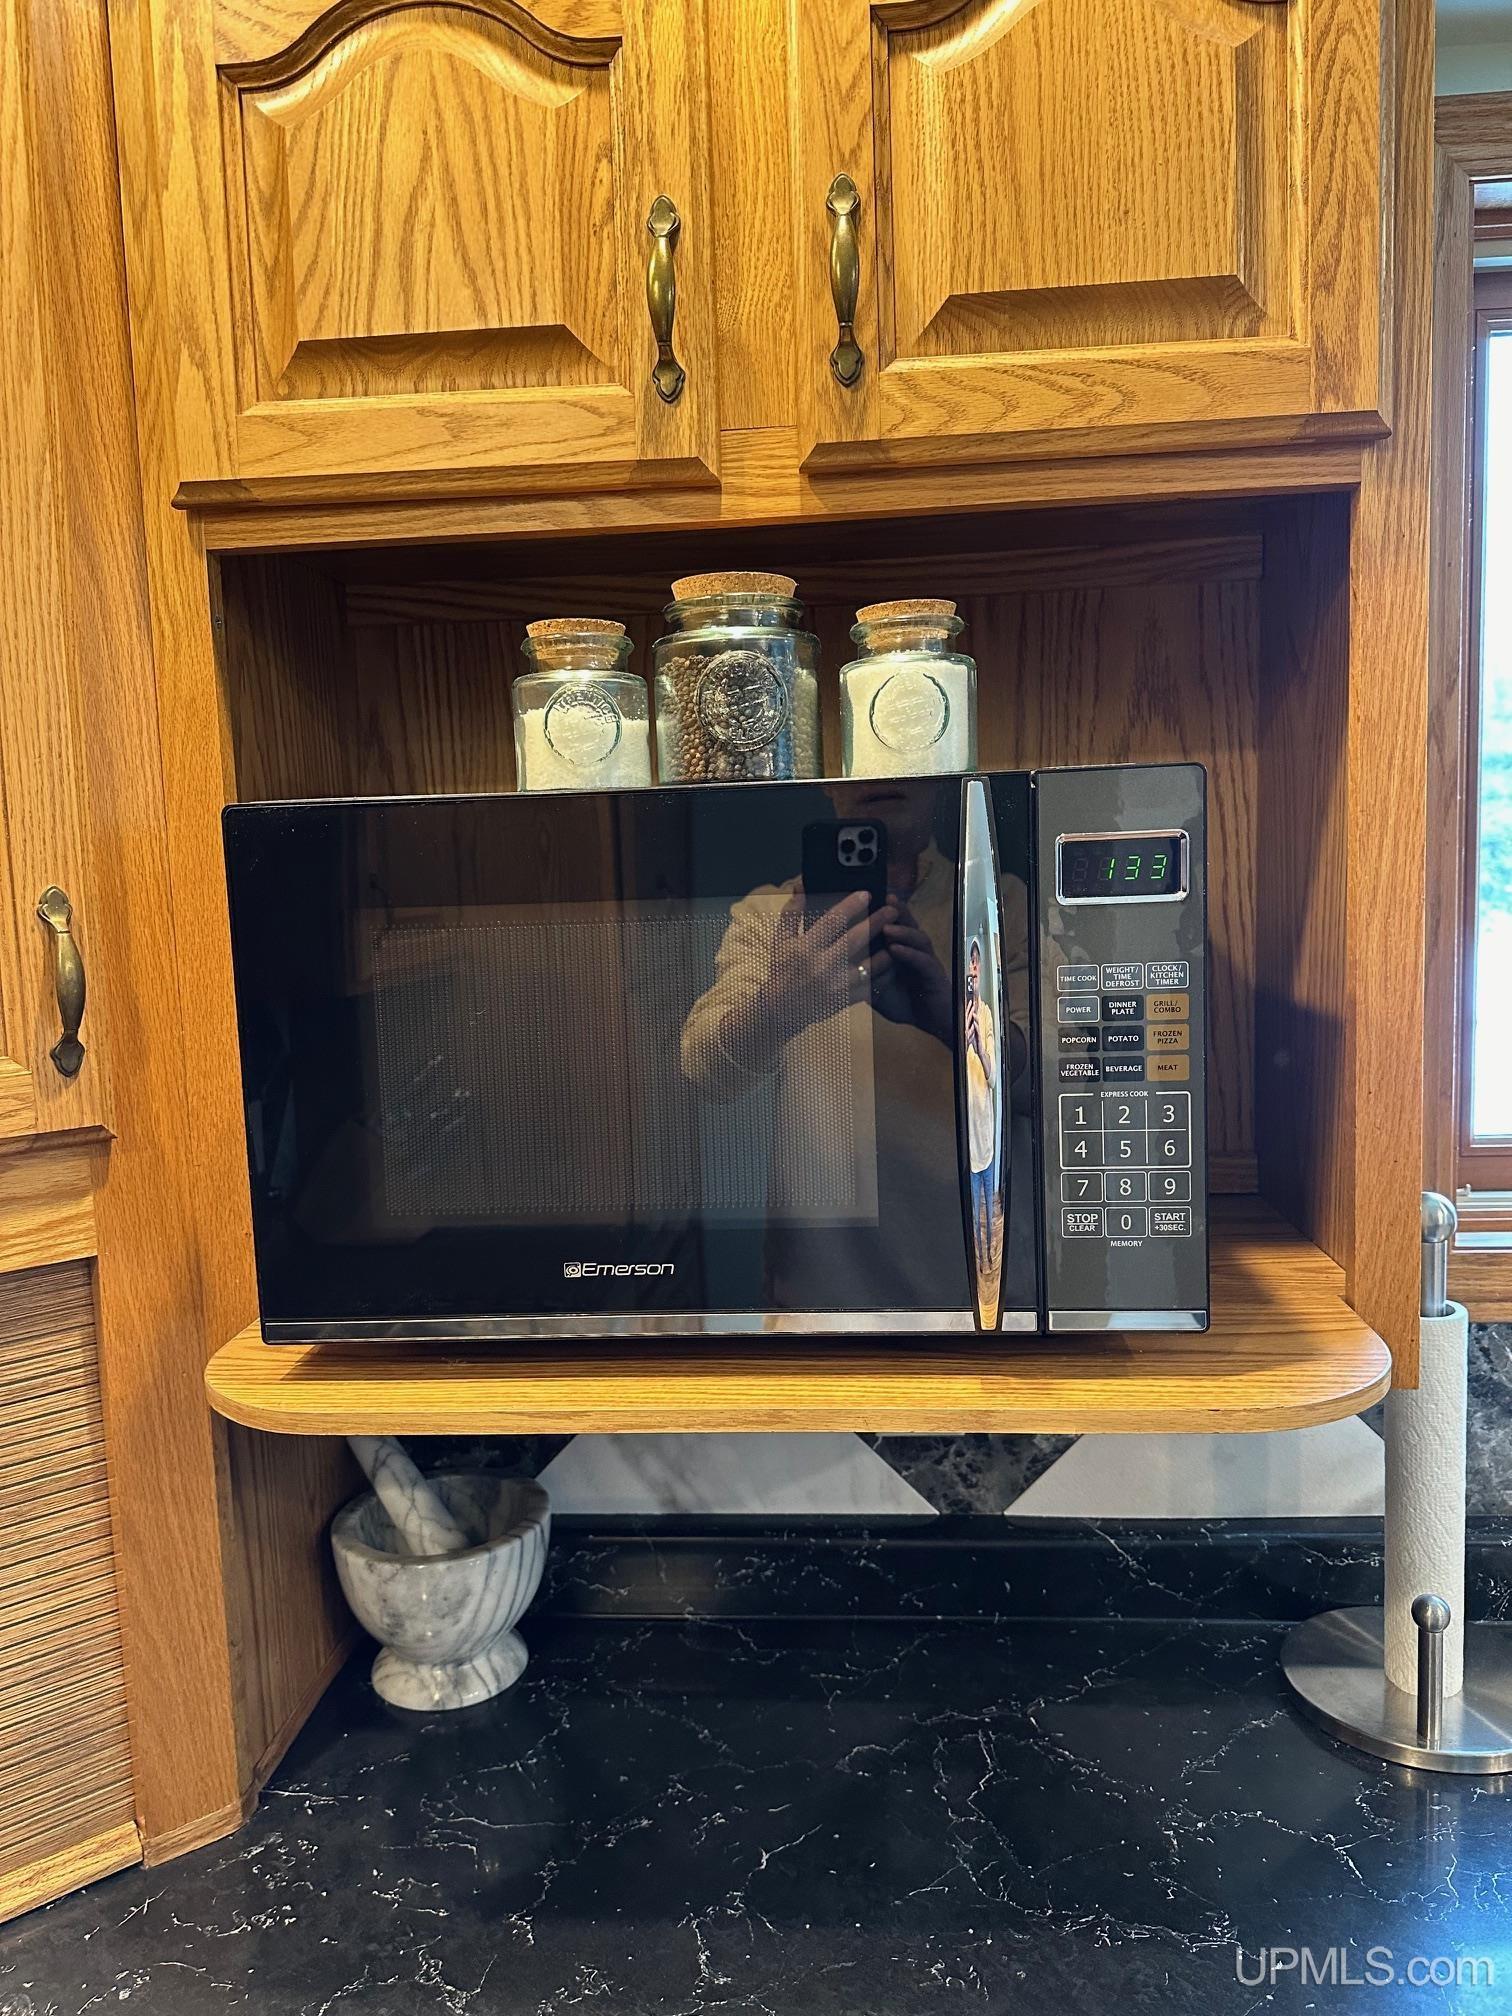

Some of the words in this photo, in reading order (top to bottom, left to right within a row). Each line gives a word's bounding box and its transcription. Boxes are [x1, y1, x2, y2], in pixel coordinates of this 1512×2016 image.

[1107, 854, 1168, 881] 133
[1105, 966, 1139, 974] WEIGHT/
[1152, 964, 1182, 972] CLOCK/
[1065, 1006, 1092, 1014] POWER
[1061, 1036, 1097, 1044] POPCORN
[1060, 1069, 1100, 1077] VEGETABLE
[1075, 1106, 1087, 1125] 1
[1118, 1105, 1131, 1124] 2
[1162, 1104, 1175, 1123] 3
[1074, 1140, 1088, 1158] 4
[1120, 1140, 1132, 1158] 5
[1164, 1139, 1176, 1156] 6
[1077, 1179, 1089, 1197] 7
[1120, 1178, 1132, 1196] 8
[1164, 1178, 1176, 1195] 9
[1067, 1213, 1099, 1223] STOP
[1121, 1214, 1132, 1230] 0
[1154, 1212, 1186, 1221] START
[582, 1263, 675, 1276] Emerson
